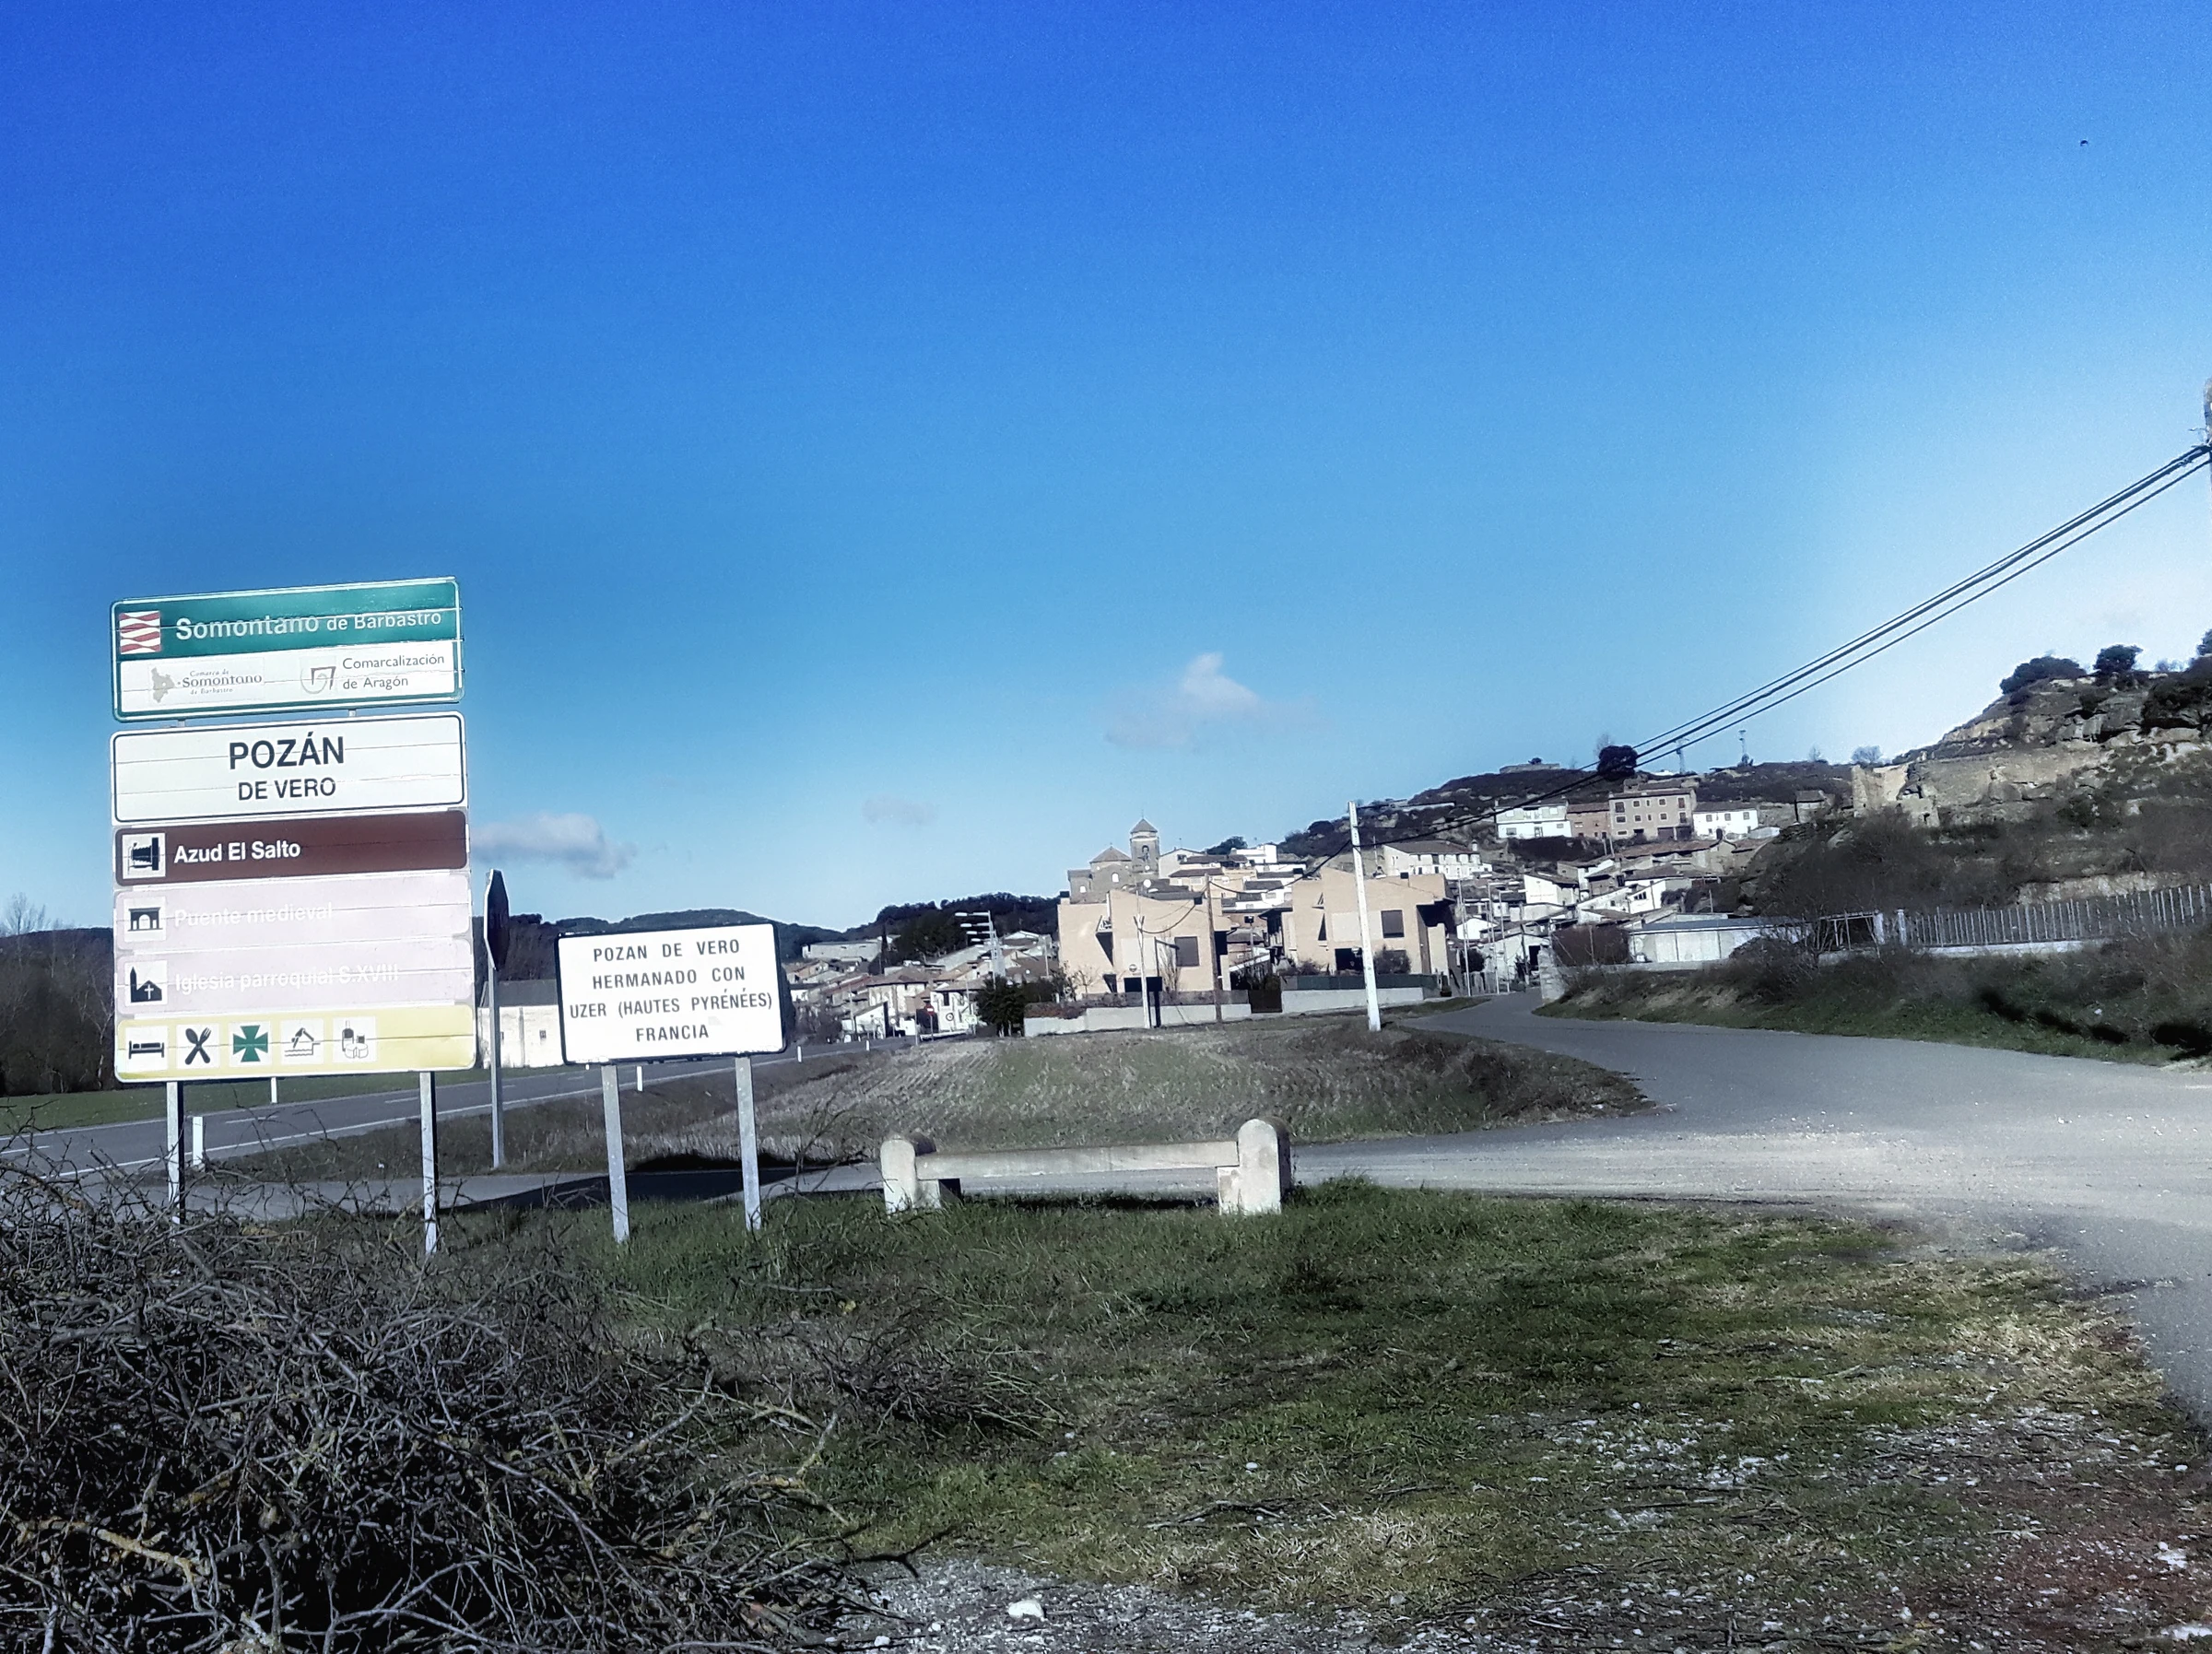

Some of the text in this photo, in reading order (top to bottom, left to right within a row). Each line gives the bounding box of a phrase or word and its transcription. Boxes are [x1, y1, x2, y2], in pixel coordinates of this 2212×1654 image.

[176, 612, 441, 640] Somontano de Barbastro
[342, 653, 444, 669] Comarcalización
[182, 675, 263, 688] Somontano
[343, 675, 408, 690] de Aragón
[229, 731, 345, 769] POZÁN
[238, 777, 336, 801] DE VERO
[173, 840, 301, 863] Azud El Salto
[174, 902, 333, 927] Puente medieval
[593, 939, 740, 962] POZAN DE VERO
[175, 972, 235, 996] Iglesia
[241, 967, 333, 992] parroquial
[592, 966, 746, 990] HERMANADO CON
[570, 987, 772, 1019] UZER (HAUTES PYRÉNÉES)
[635, 1024, 710, 1042] FRANCIA
